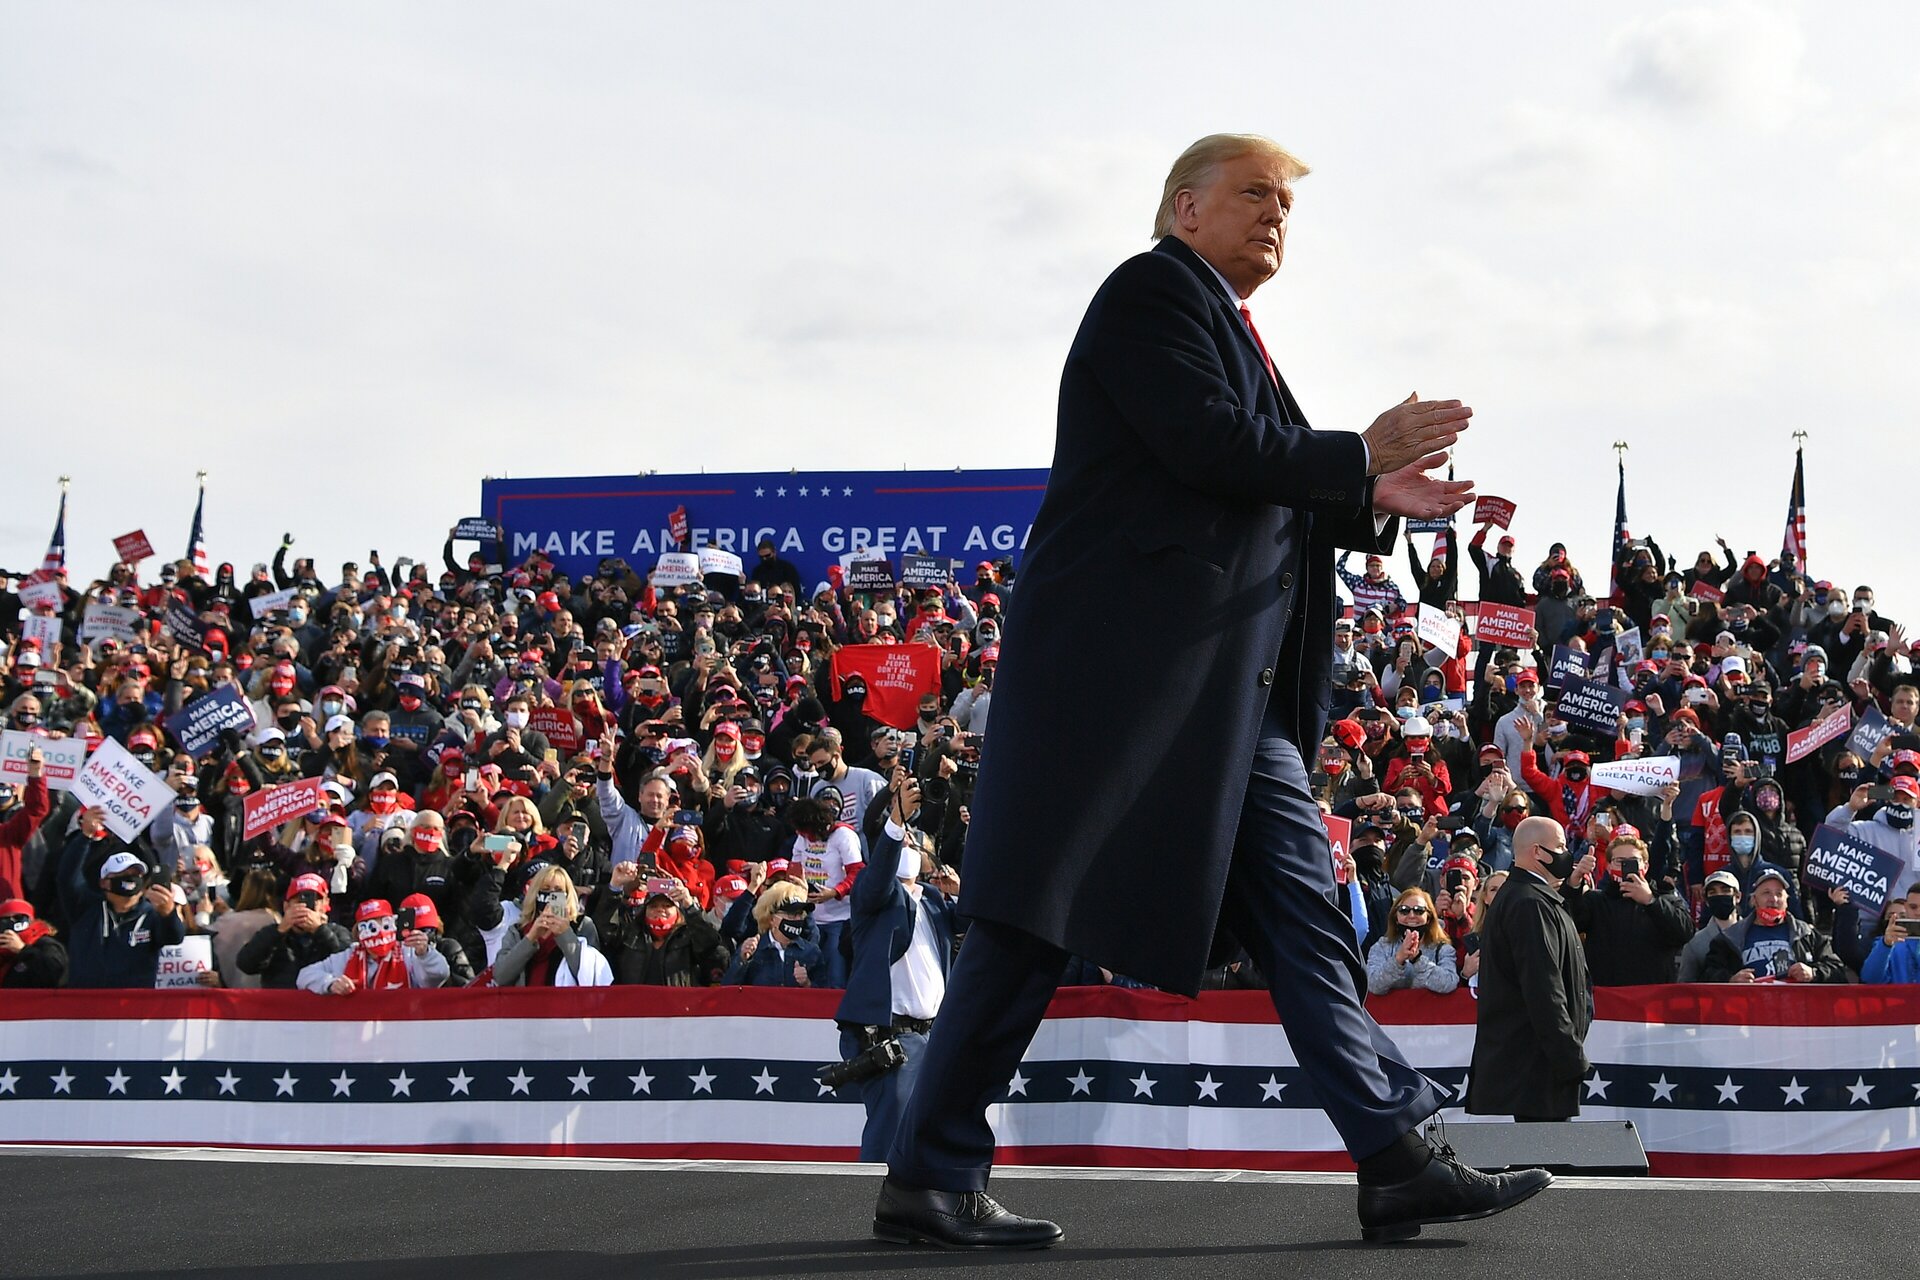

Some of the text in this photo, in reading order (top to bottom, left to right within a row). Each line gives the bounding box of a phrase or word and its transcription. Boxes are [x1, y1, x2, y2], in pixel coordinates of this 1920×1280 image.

[1476, 504, 1511, 519] AMERICA
[457, 524, 496, 533] AMERICA
[513, 530, 616, 557] MAKE
[631, 526, 805, 556] AMERICA
[822, 526, 948, 553] GREAT
[851, 573, 892, 582] AMERICA
[903, 568, 948, 577] AMERICA
[1497, 610, 1519, 620] MAKE
[1480, 616, 1531, 632] AMERICA
[1479, 627, 1530, 641] GREAT AGAI
[885, 660, 911, 668] PEOPLE
[888, 653, 910, 661] BLACK
[900, 668, 917, 677] HAVE
[875, 680, 914, 692] DEMOCRATS
[1582, 686, 1608, 700] MAKE
[189, 700, 219, 720] MAKE
[1561, 691, 1620, 717] AMERICA
[181, 701, 245, 743] AMERICA
[534, 712, 557, 721] MAKE
[1558, 704, 1617, 727] GREAT AGAIN
[186, 711, 250, 751] GREAT AGAIN
[529, 720, 573, 733] MERICA
[549, 732, 574, 742] AGAIN
[6, 742, 76, 765] Lanos
[5, 761, 28, 771] FOR
[1598, 765, 1674, 779] AMERICA
[113, 761, 146, 790] MAKE
[1596, 771, 1635, 781] GREAT
[88, 761, 153, 818] AMERICA
[265, 785, 296, 801] MAKE
[80, 774, 141, 829] GREAT AGAIN
[248, 787, 316, 821] AMERICA
[247, 797, 316, 831] GREAT AGAIN
[1887, 806, 1913, 819] MAGA
[1837, 842, 1874, 866] MAKE
[1809, 847, 1889, 893] AMERICA
[1806, 863, 1885, 905] GREAT AGAIN
[783, 923, 803, 936] TRU
[157, 960, 206, 974] RICA
[167, 976, 198, 987] AGAI
